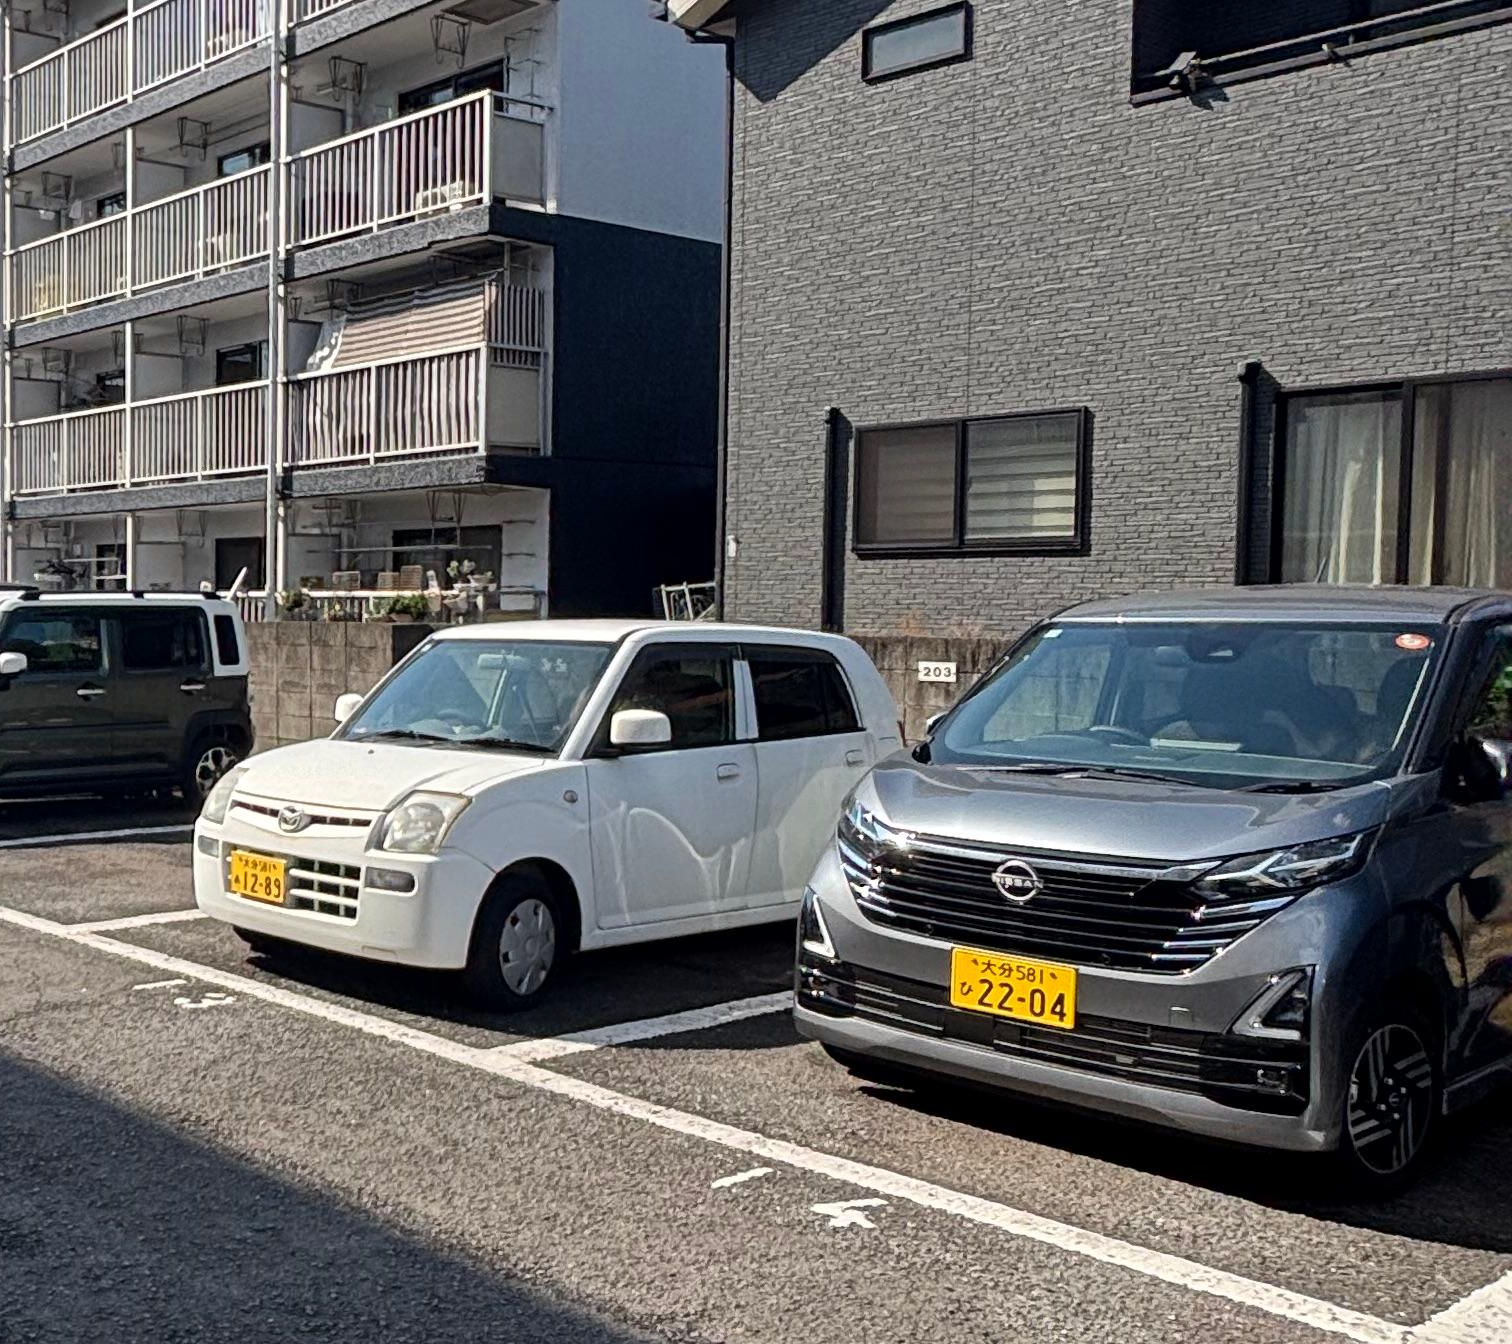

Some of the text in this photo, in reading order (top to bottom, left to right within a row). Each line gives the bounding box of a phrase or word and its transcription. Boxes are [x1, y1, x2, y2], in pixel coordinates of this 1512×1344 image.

[923, 666, 952, 678] 203
[243, 871, 281, 899] 12-89
[991, 872, 1044, 889] NISSAN
[960, 978, 1067, 1023] ひ 22-04
[710, 1166, 890, 1229] 14
